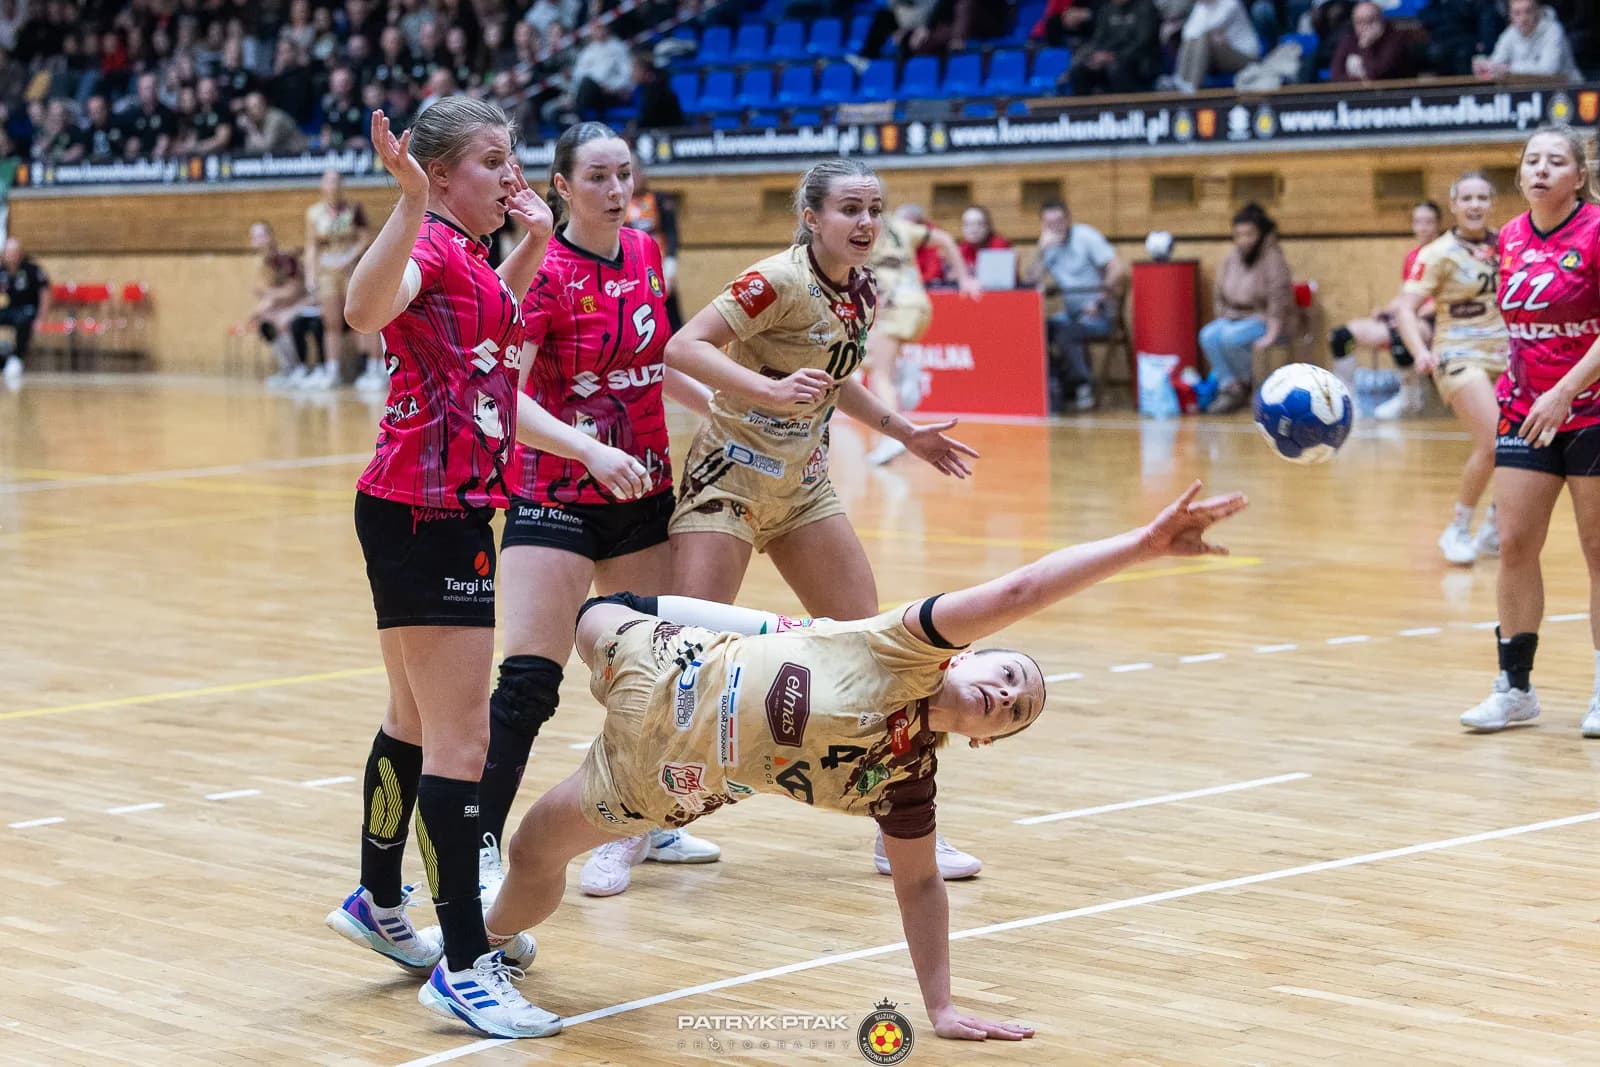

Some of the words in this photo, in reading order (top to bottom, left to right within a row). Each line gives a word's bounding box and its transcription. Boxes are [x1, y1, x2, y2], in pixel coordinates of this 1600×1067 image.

[950, 108, 1170, 145] www.koronahandball.pl
[1280, 92, 1542, 131] www.koronahandball.pl
[1501, 271, 1555, 311] 22
[632, 303, 656, 354] 5
[607, 363, 666, 390] SUZ
[825, 340, 858, 380] 10
[518, 505, 545, 519] Targi
[444, 577, 479, 594] Targi
[782, 675, 803, 737] elmas
[820, 745, 868, 770] 4
